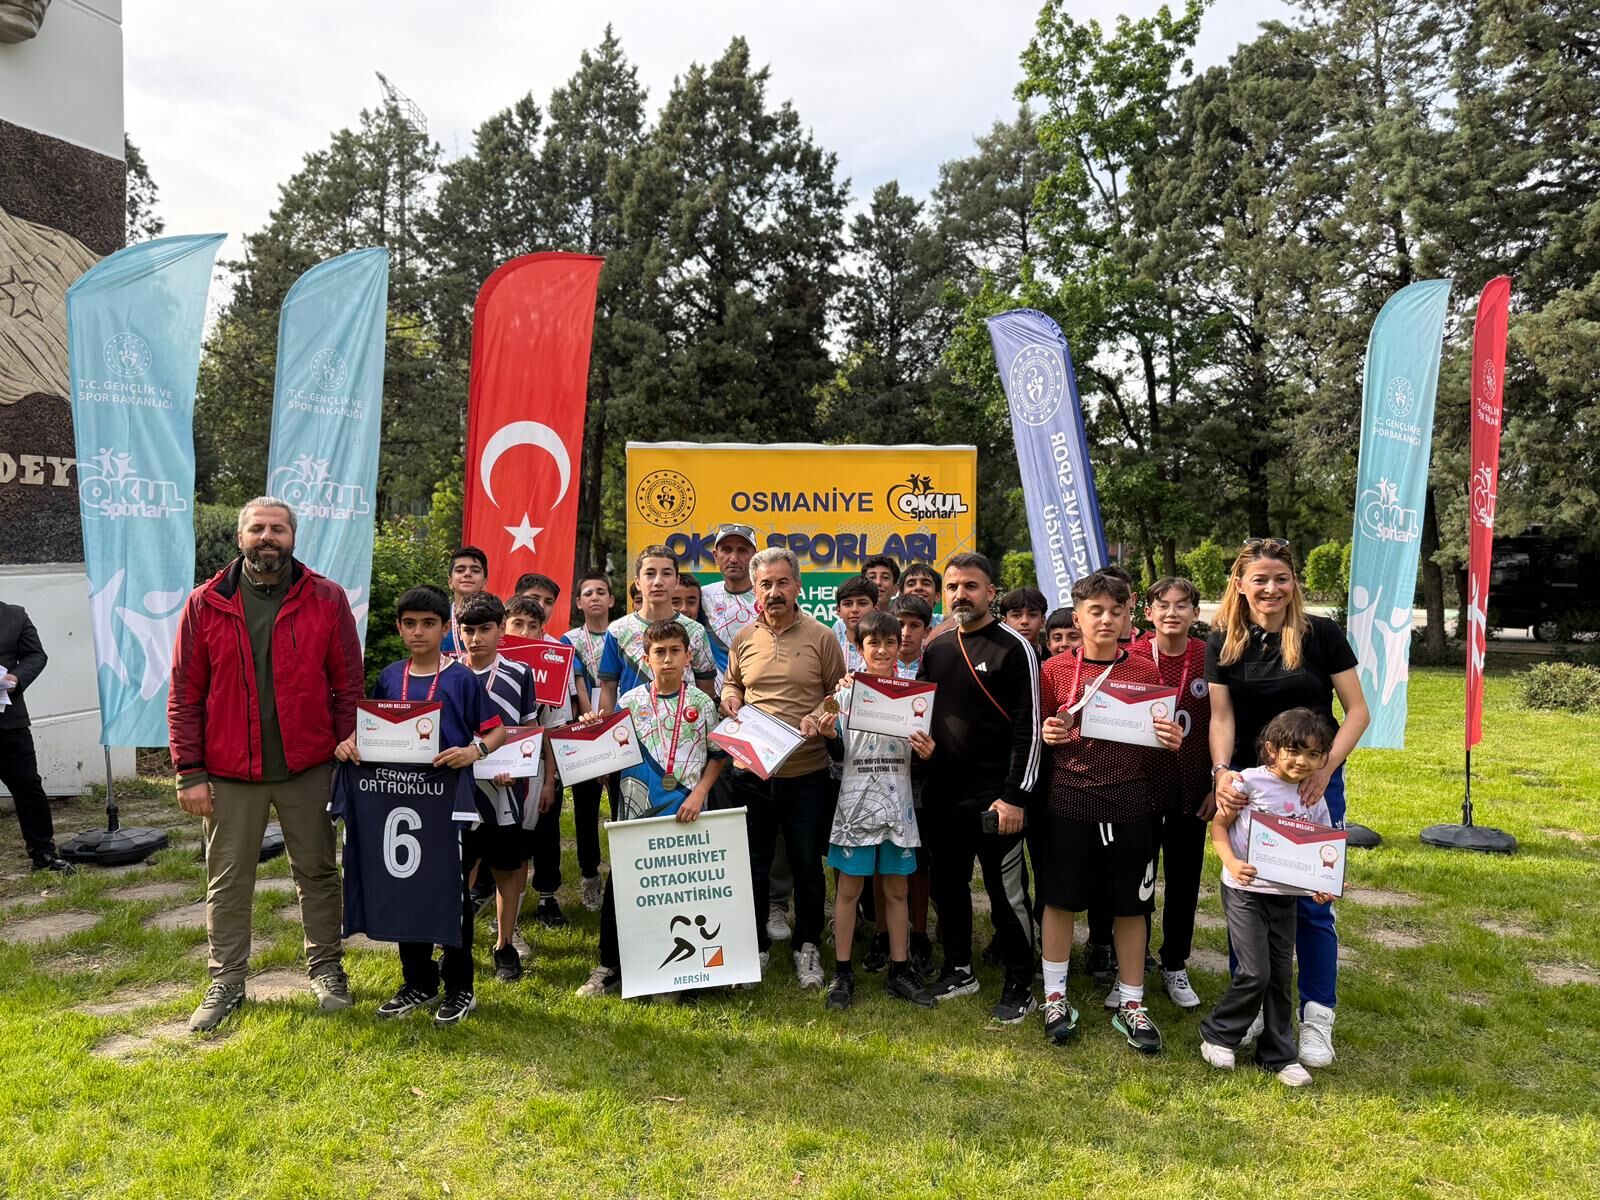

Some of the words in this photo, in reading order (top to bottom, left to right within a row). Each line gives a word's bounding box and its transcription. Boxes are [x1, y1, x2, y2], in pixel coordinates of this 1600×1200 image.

[80, 379, 101, 390] T.C.
[103, 381, 156, 395] GENÇLİK
[160, 388, 173, 400] VE
[79, 391, 109, 402] SPOR
[112, 394, 173, 411] BAKANLIĞI
[288, 400, 312, 412] SPOR
[309, 393, 350, 407] GENÇLİK
[351, 399, 362, 409] VE
[79, 475, 188, 512] OKUL
[281, 480, 370, 515] OKUL
[731, 487, 874, 513] OSMANİYE
[898, 492, 969, 514] OKUL
[100, 499, 169, 520] Sporları
[910, 507, 957, 521] Sporları
[766, 533, 937, 567] SPORLARI
[376, 768, 427, 783] FERNAS
[359, 779, 444, 796] ORTAOKULU
[383, 806, 422, 879] 6
[648, 830, 711, 851] ERDEMLİ
[634, 849, 728, 871] CUMHURİYET
[639, 868, 726, 889] ORTAOKULU
[636, 885, 734, 908] ORYANTİRİNG
[673, 972, 711, 985] MERSİN
